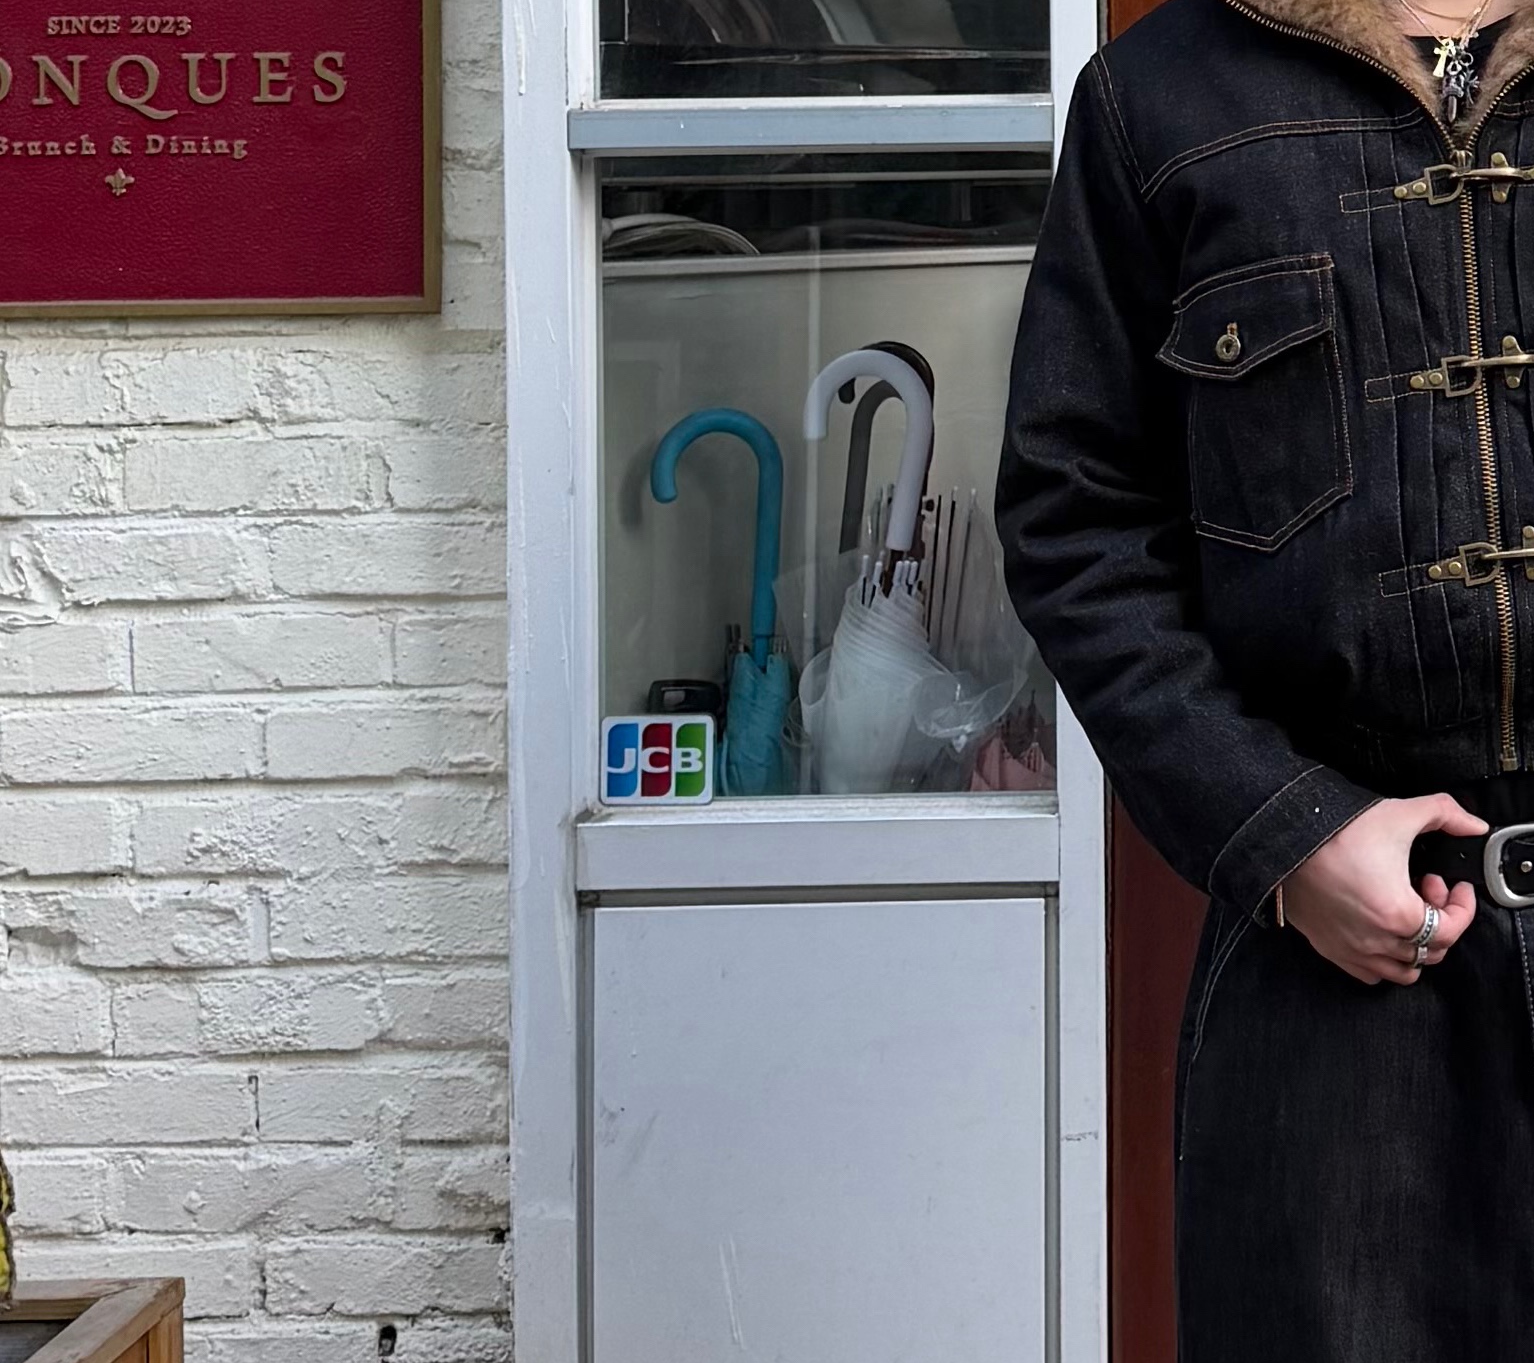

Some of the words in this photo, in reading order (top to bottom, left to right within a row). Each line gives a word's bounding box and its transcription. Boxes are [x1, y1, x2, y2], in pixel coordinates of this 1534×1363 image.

[47, 15, 121, 35] SINCE
[0, 51, 348, 120] NQUES
[111, 136, 132, 155] &
[145, 134, 249, 159] Dining
[607, 746, 704, 774] JCB
